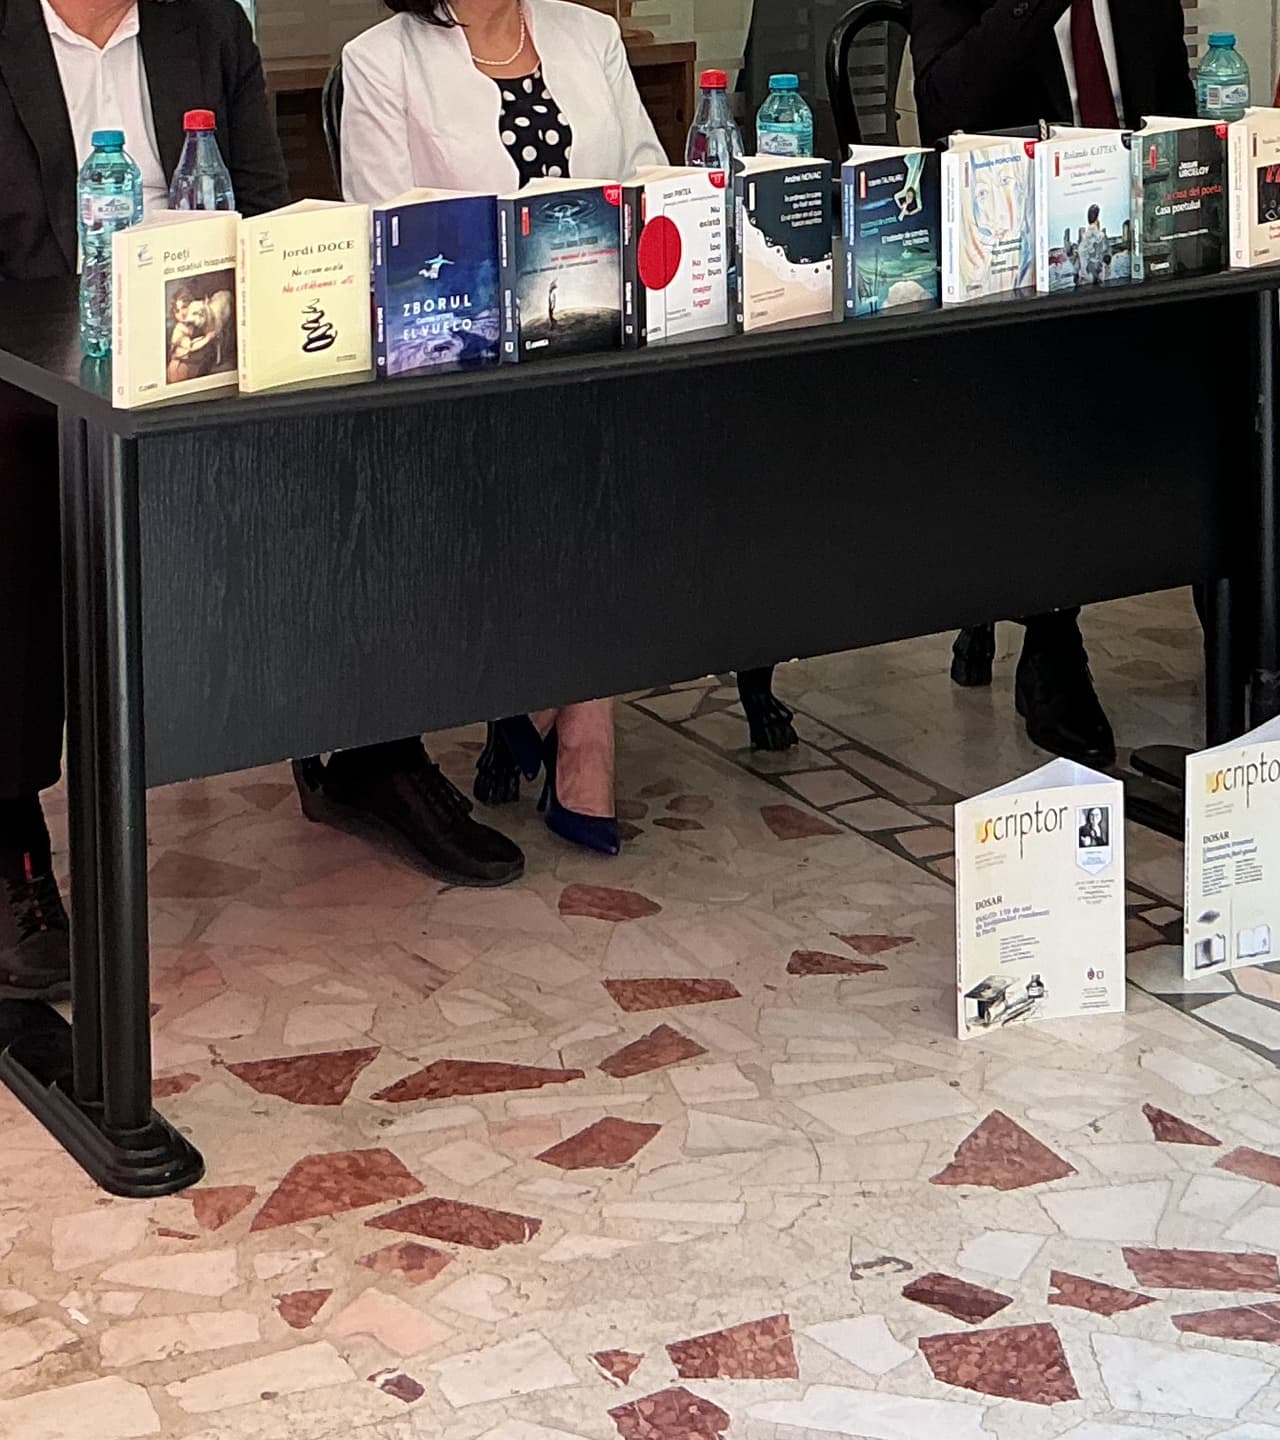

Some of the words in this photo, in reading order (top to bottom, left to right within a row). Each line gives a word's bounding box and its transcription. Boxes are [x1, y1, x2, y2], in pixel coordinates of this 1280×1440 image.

[283, 245, 313, 260] Jordi
[318, 240, 354, 253] DOCE
[403, 294, 472, 317] ZBORUL
[980, 798, 1068, 859] scriptor
[1203, 830, 1230, 844] DOSAR
[975, 895, 1003, 911] DOSAR
